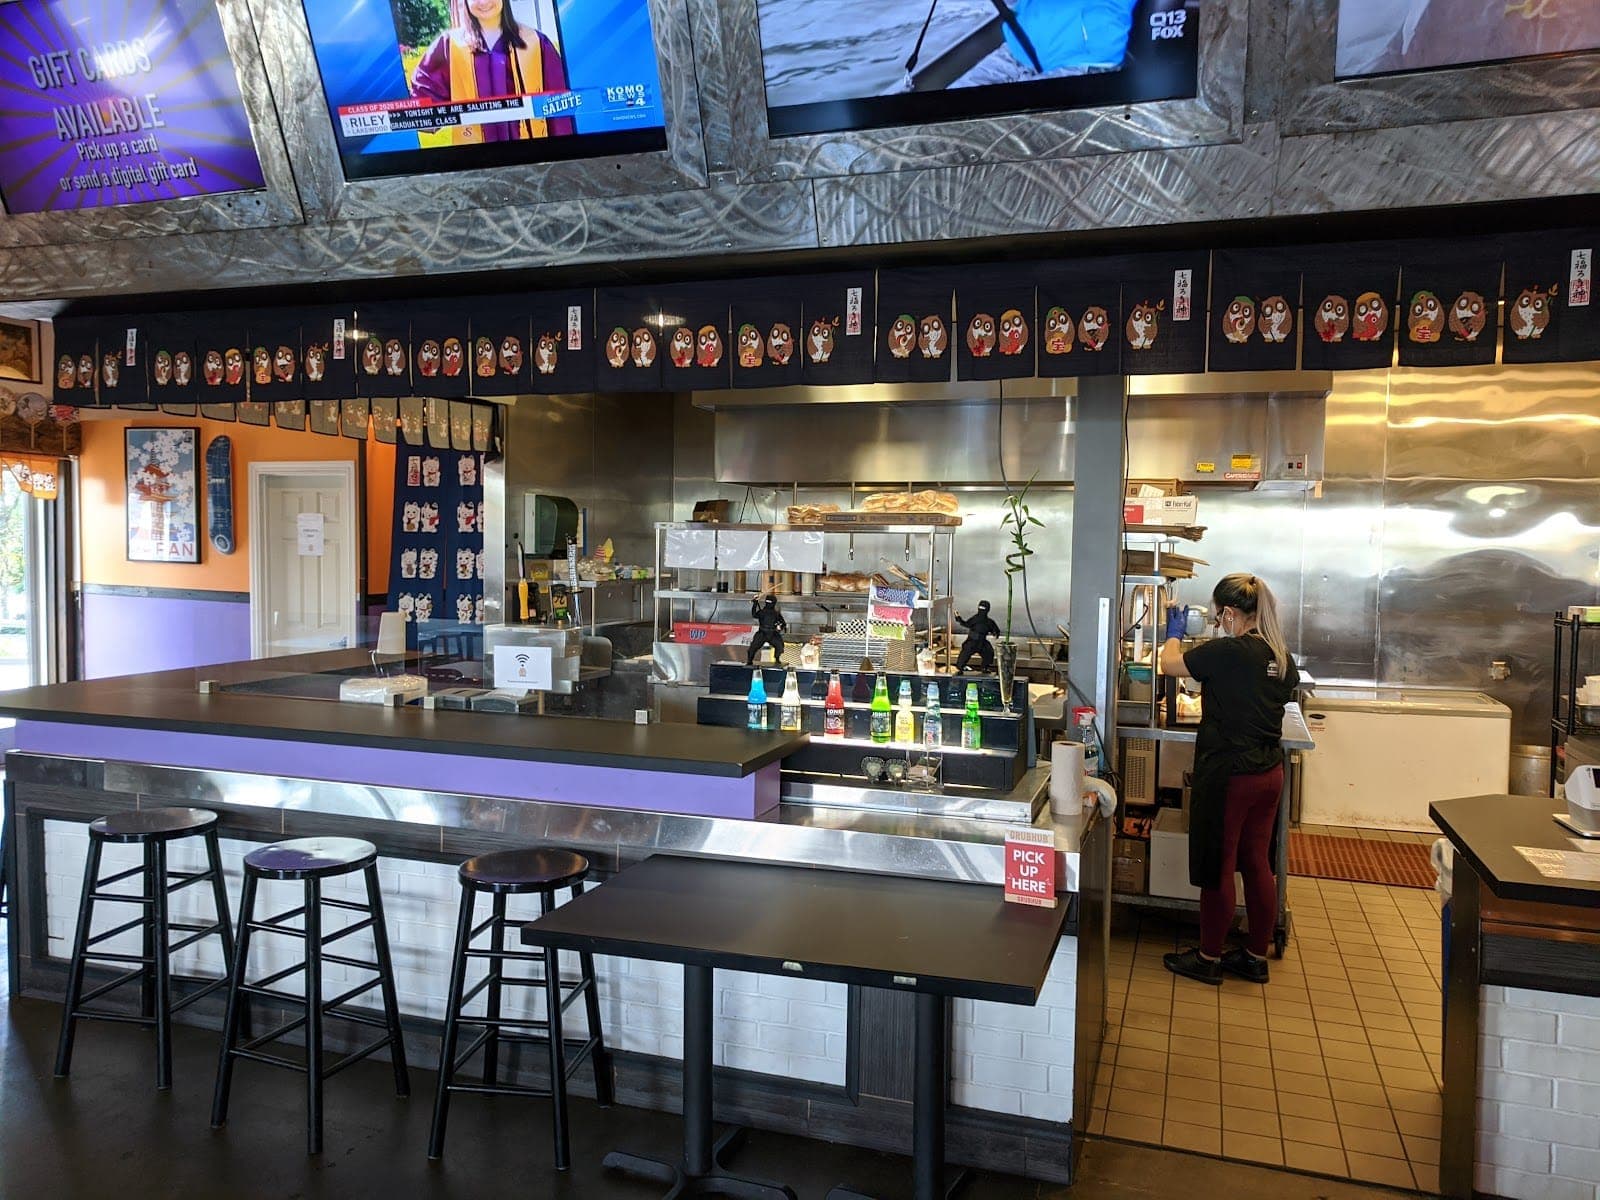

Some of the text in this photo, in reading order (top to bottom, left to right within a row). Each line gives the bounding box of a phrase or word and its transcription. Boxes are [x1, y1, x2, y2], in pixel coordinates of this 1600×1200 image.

[1150, 9, 1187, 27] Q13
[1151, 24, 1184, 40] FOX
[28, 39, 152, 90] GIFT CARDS
[607, 84, 644, 97] KOMO
[608, 92, 645, 102] NEWS
[370, 104, 379, 112] OF
[380, 102, 395, 111] 2020
[396, 100, 421, 109] SALUTE
[404, 107, 434, 117] TONIGHT
[438, 106, 447, 114] WE
[450, 104, 464, 113] ARE
[467, 101, 502, 111] SALUTING
[506, 99, 520, 108] THE
[542, 95, 582, 115] SALUTE
[635, 98, 646, 106] 4
[53, 94, 166, 142] AVAILABLE
[349, 115, 385, 128] RILEY
[390, 117, 457, 129] GRADUATING CLASS
[76, 134, 159, 162] Pick up a card
[59, 157, 199, 191] or send a digital gift card
[1013, 849, 1045, 865] PICK
[1019, 864, 1039, 878] UP
[1011, 877, 1047, 894] HERE
